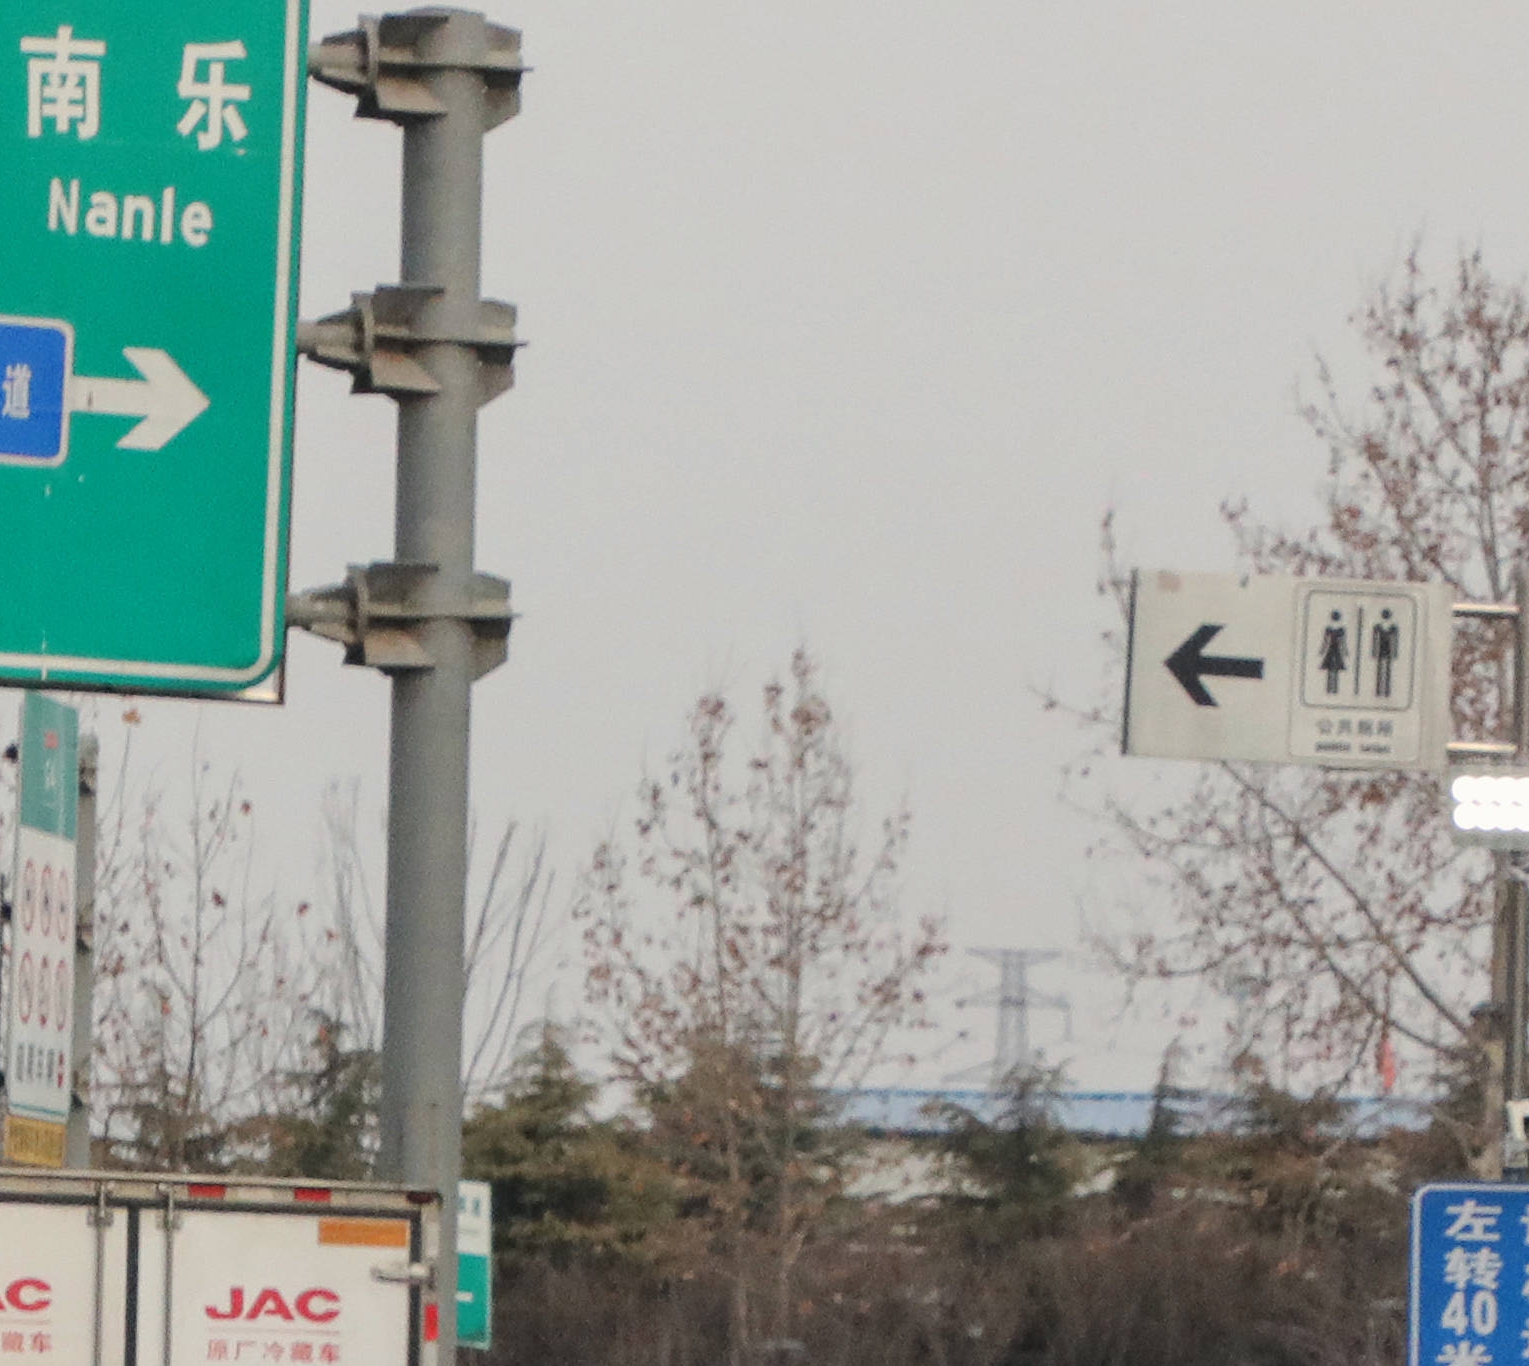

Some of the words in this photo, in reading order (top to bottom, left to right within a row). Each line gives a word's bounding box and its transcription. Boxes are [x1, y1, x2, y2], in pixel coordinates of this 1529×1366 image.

[47, 177, 213, 247] Nanle
[205, 1287, 341, 1323] JAC
[206, 1339, 341, 1364] 原厂冷藏车
